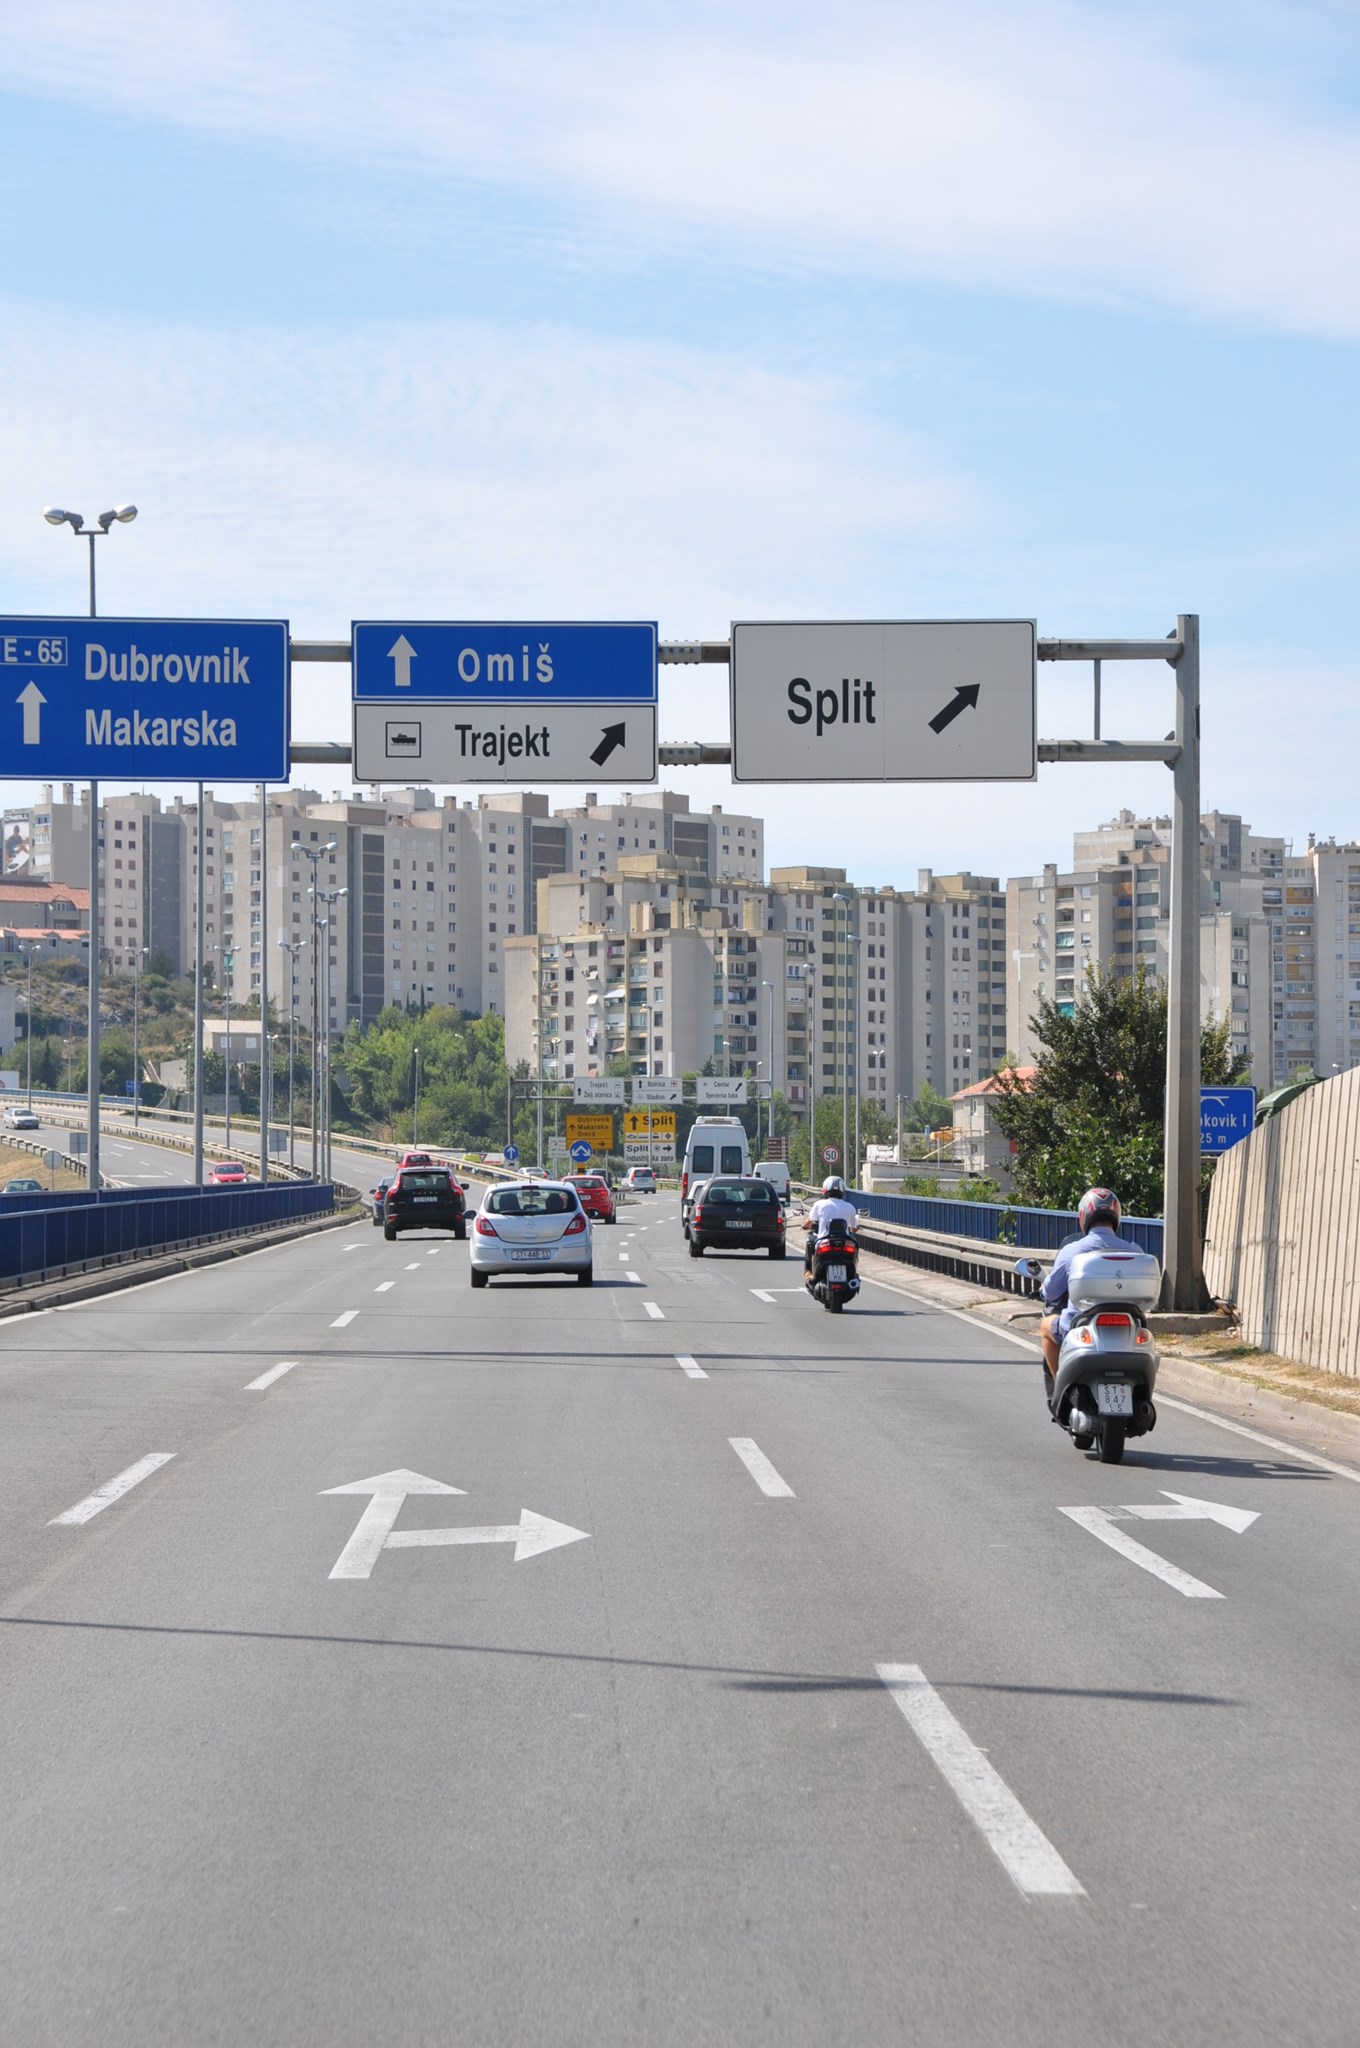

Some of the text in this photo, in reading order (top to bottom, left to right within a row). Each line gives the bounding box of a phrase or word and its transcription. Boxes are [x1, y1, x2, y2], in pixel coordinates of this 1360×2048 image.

[84, 643, 250, 684] Dubrovnik
[457, 643, 554, 684] Omiš
[787, 677, 876, 737] Split
[84, 708, 238, 747] Makarska
[455, 724, 551, 765] Trajekt
[590, 1081, 608, 1089] Trajekt
[705, 1091, 727, 1100] Sjeverna
[642, 1115, 674, 1128] Split
[1217, 1135, 1226, 1144] m
[626, 1144, 649, 1154] Split
[825, 1150, 837, 1161] 50
[1104, 1386, 1117, 1395] ST
[1105, 1395, 1125, 1403] 847
[1110, 1404, 1123, 1412] LS
